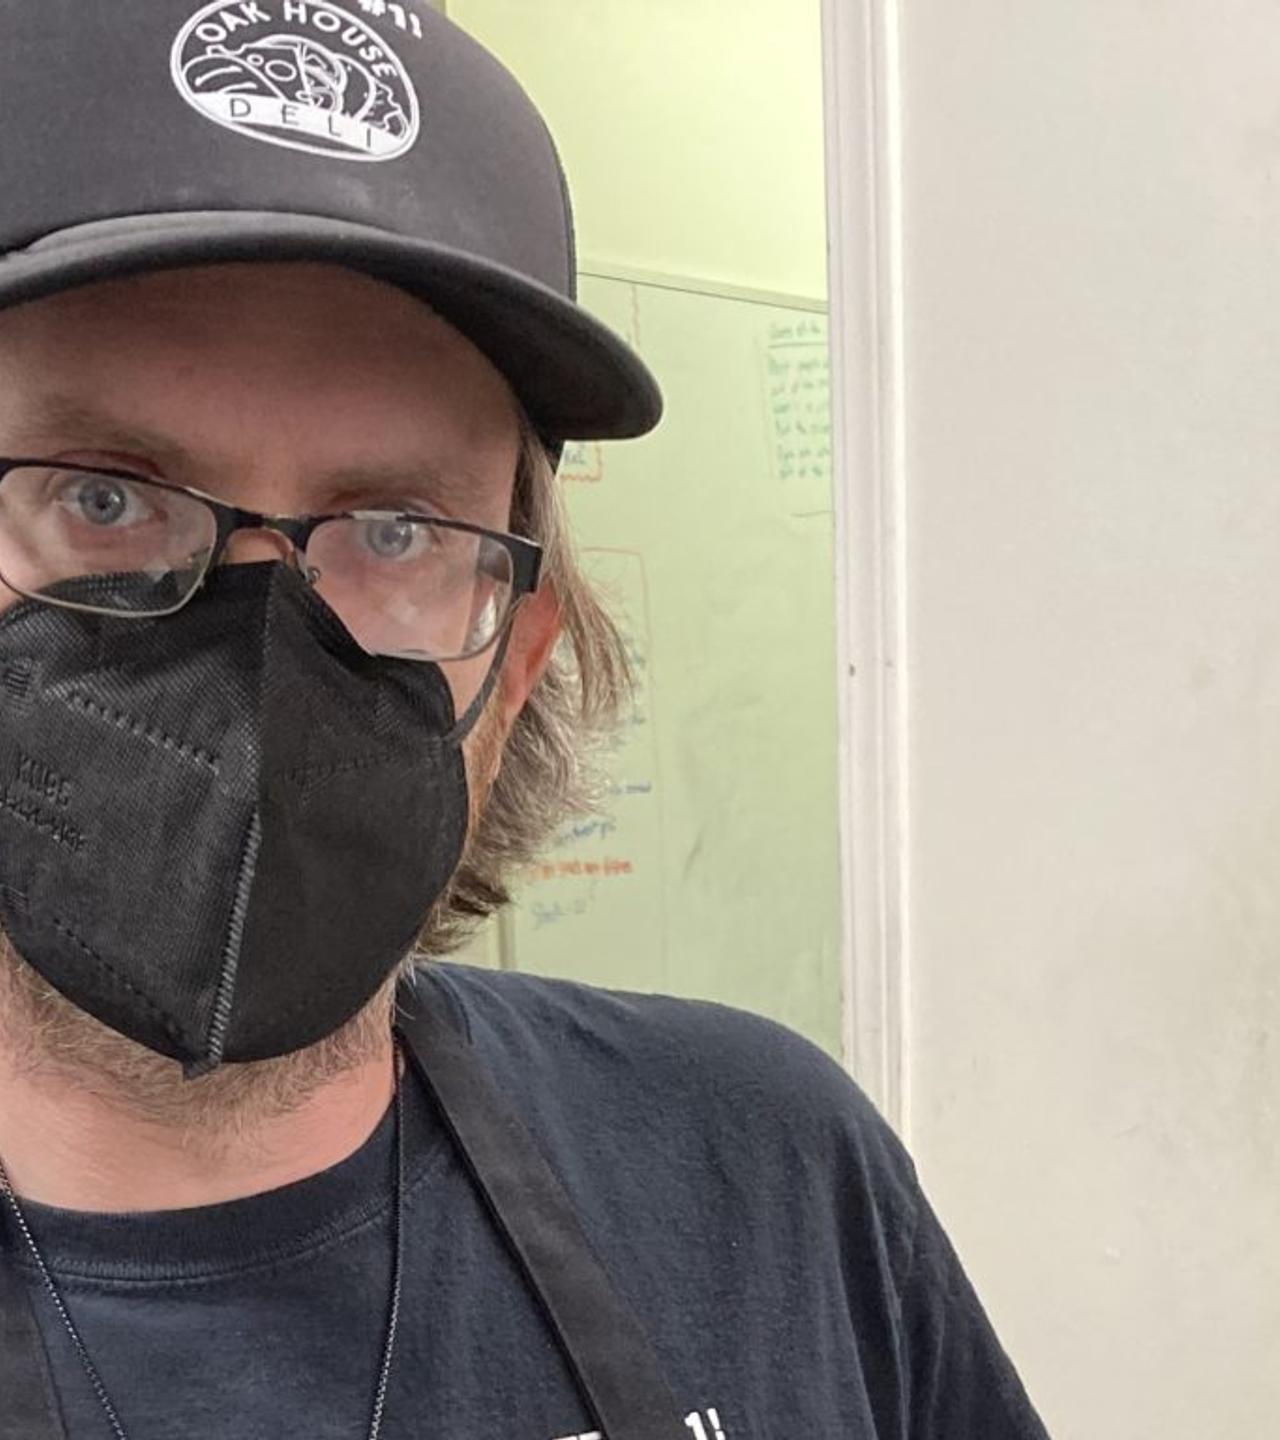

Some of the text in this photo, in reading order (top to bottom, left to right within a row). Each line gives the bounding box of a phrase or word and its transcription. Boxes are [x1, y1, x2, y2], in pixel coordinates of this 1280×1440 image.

[196, 0, 398, 79] OAK HOUSE
[230, 98, 372, 148] DELI
